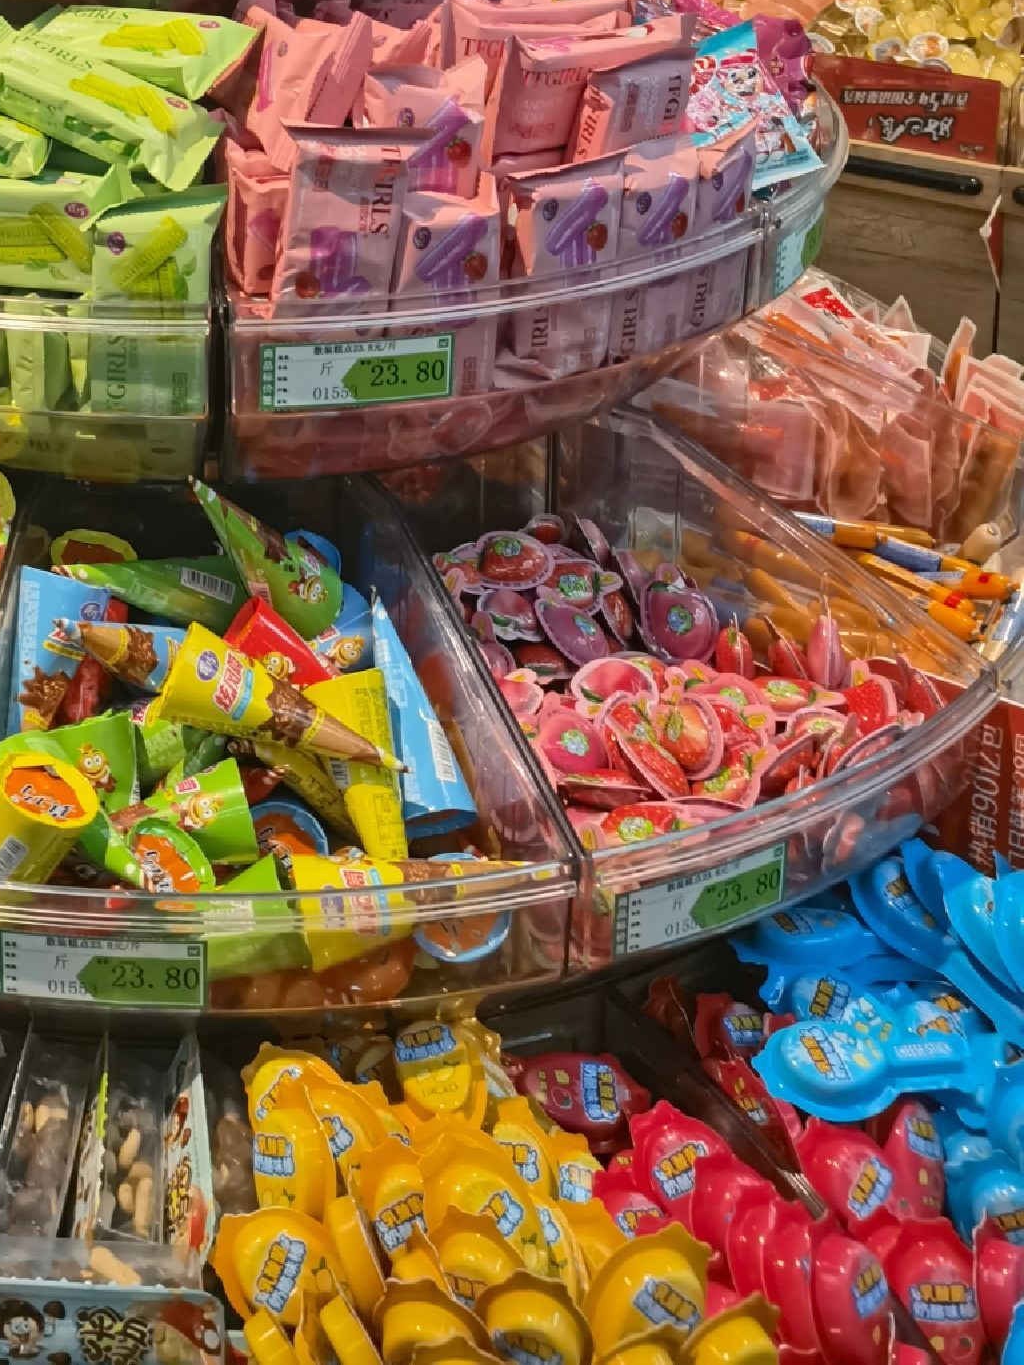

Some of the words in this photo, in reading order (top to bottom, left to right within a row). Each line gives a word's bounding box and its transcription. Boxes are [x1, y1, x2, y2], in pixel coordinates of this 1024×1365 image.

[370, 358, 446, 389] 23.80
[715, 867, 781, 912] 23.80
[111, 964, 201, 991] 23.80
